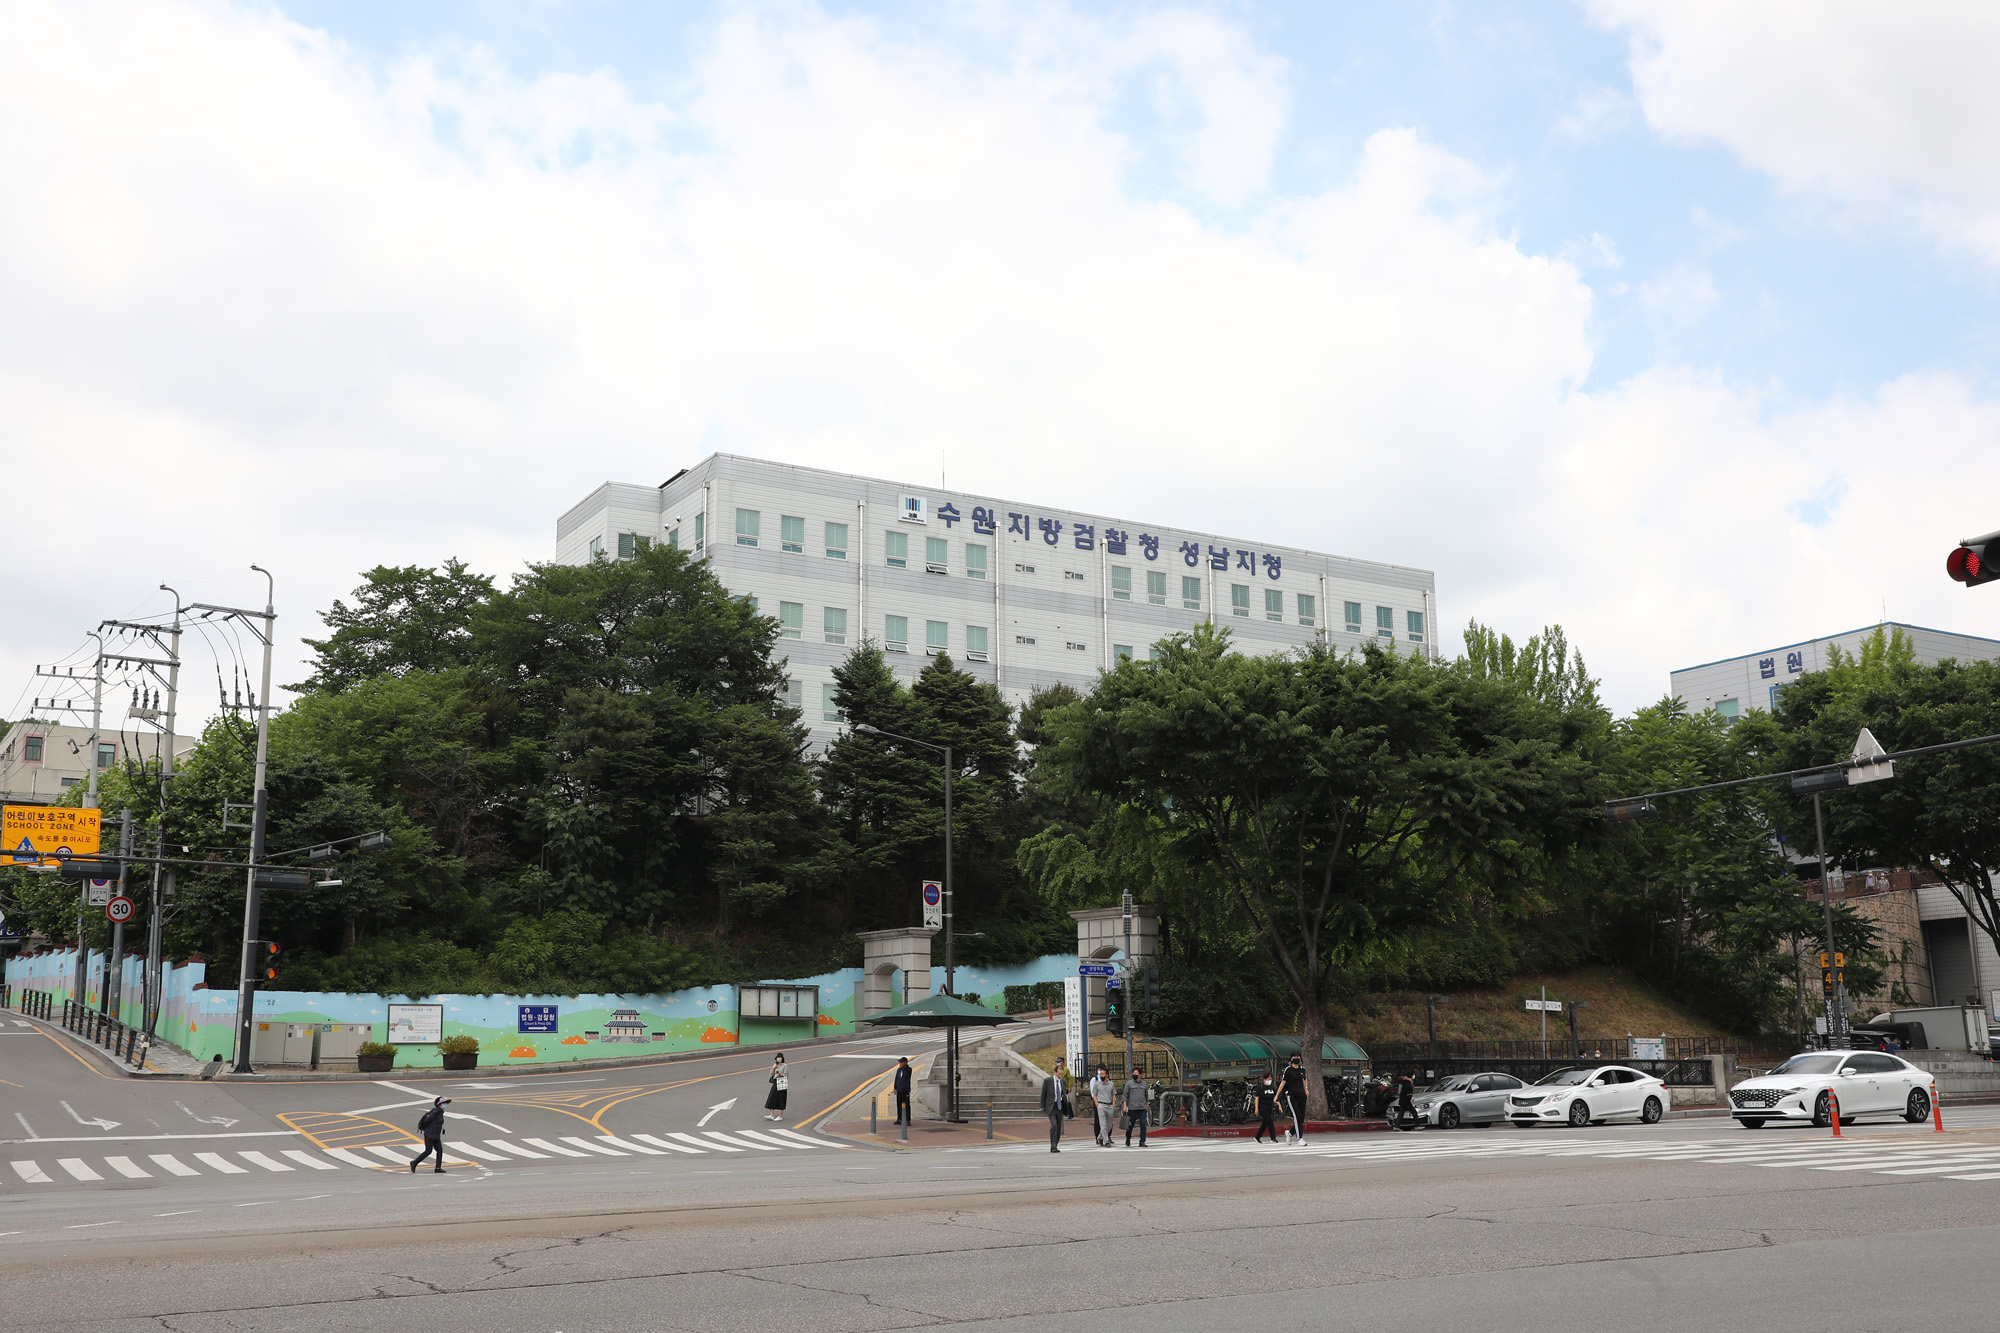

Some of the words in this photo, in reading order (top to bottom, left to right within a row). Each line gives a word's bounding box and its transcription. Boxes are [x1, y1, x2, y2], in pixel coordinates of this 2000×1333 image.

[937, 502, 1159, 561] 수원지방검찰청
[1179, 541, 1282, 580] 성남지청
[1759, 651, 1803, 679] 법원
[6, 811, 76, 822] 어린이보호구역
[78, 817, 96, 826] 시작
[6, 821, 44, 829] SCHOOL
[113, 904, 128, 915] 30
[1825, 972, 1832, 984] 4
[1837, 972, 1844, 983] 4
